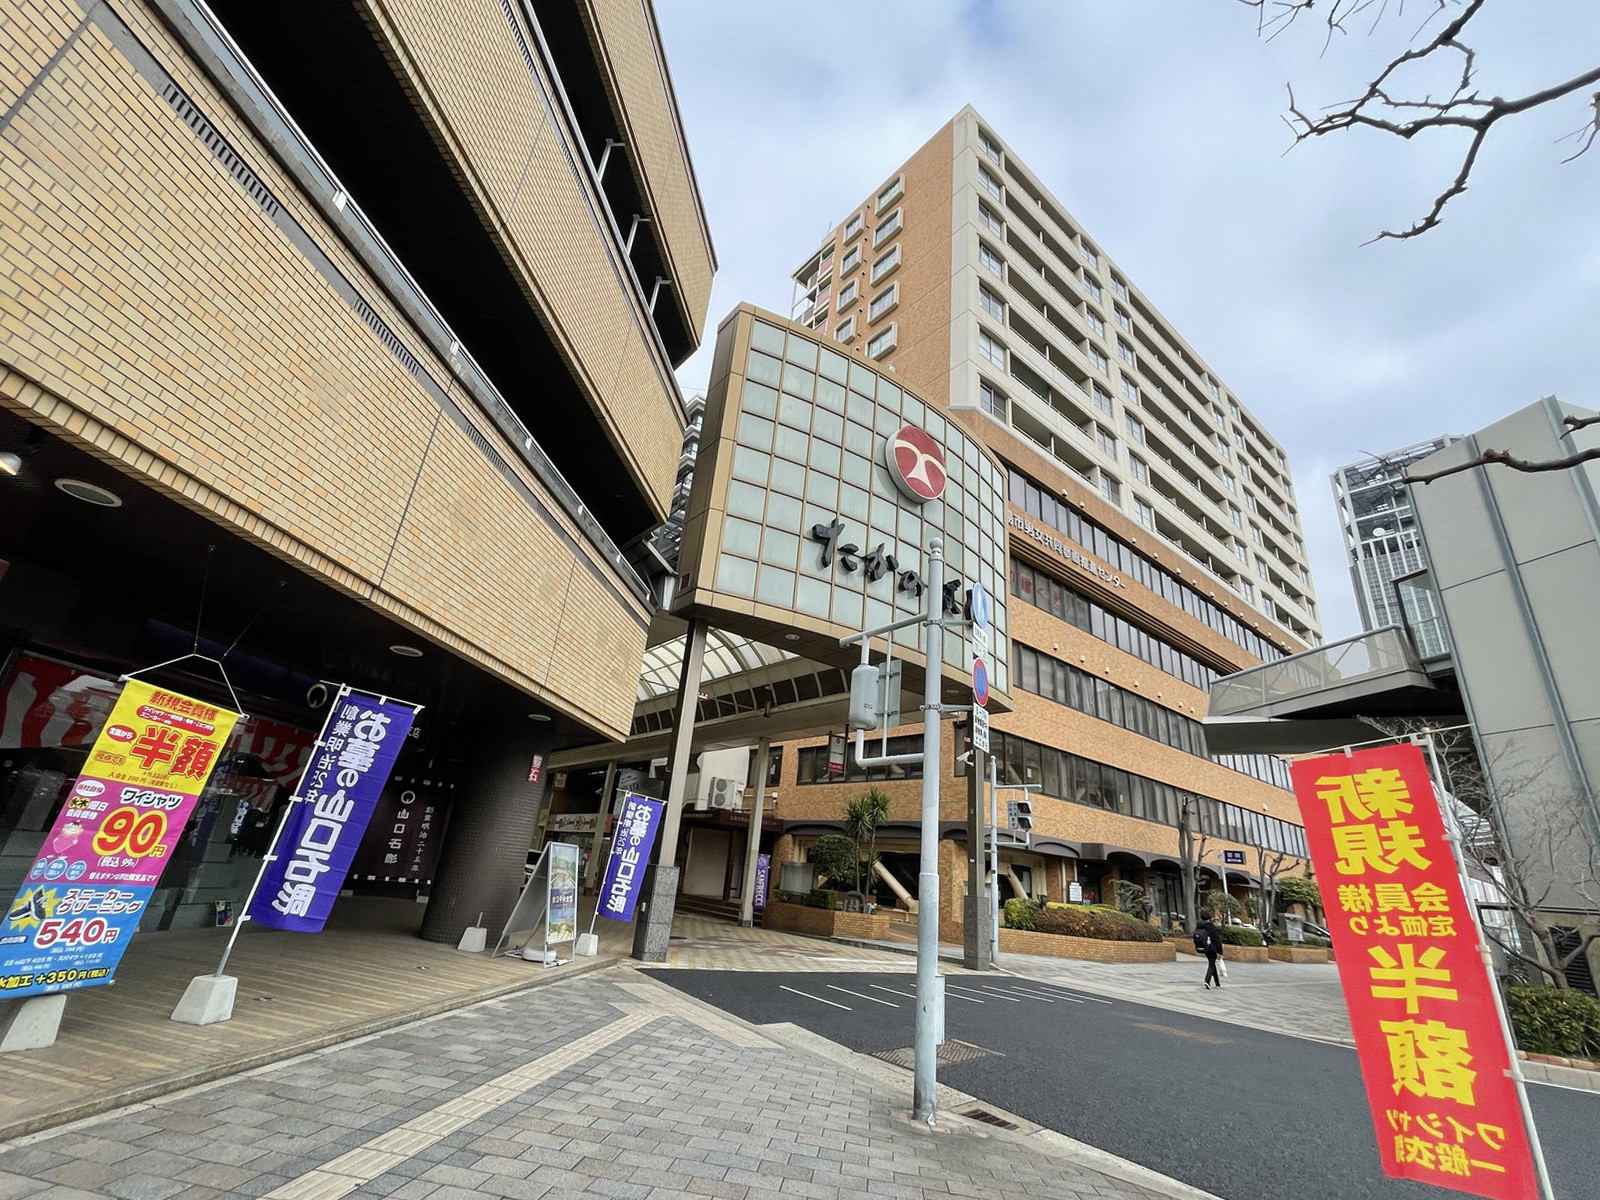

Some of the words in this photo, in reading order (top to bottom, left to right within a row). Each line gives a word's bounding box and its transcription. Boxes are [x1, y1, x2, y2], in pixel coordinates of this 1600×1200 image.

[149, 690, 219, 721] 新規会員様
[129, 725, 220, 781] 半額
[121, 787, 184, 810] ワイシャツ
[64, 888, 135, 901] スニーカー
[56, 900, 144, 915] クリーニング
